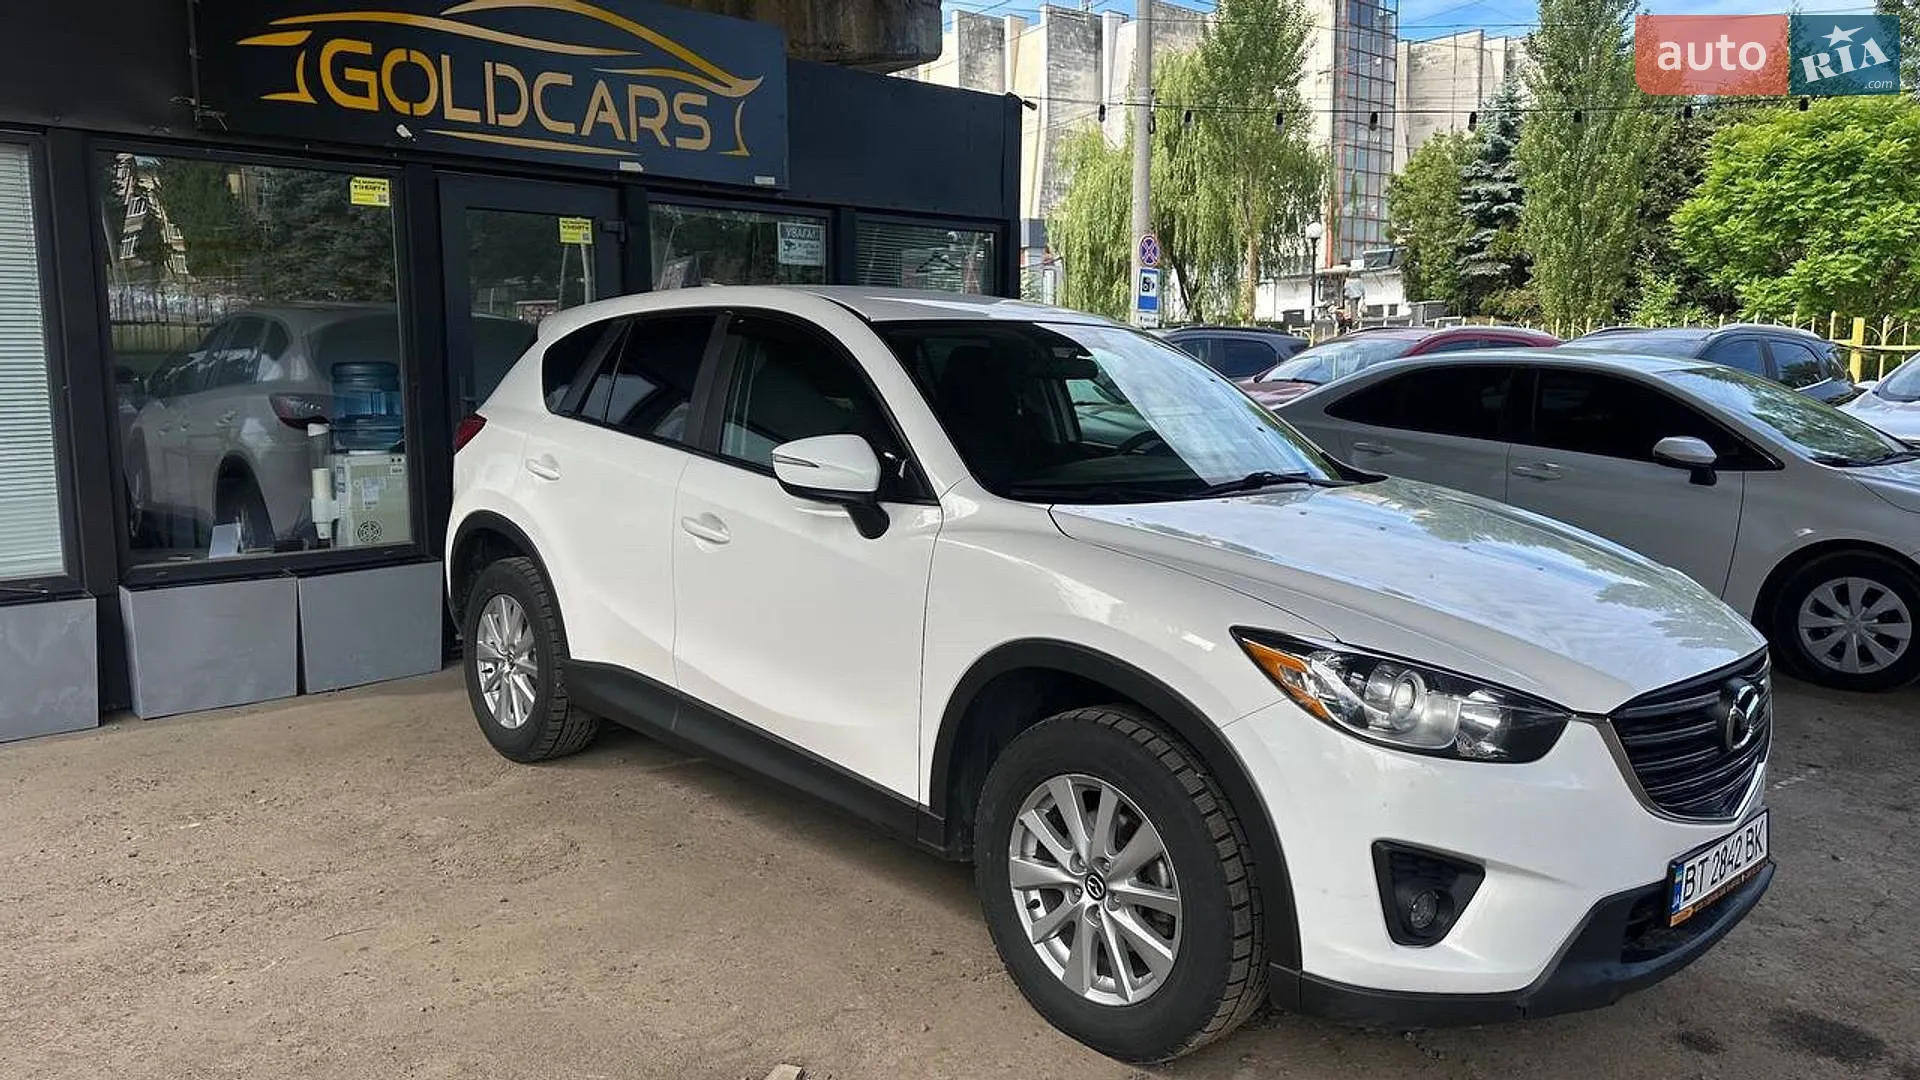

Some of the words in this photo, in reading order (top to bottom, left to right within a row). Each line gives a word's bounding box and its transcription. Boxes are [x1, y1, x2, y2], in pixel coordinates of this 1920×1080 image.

[319, 38, 711, 151] GOLDCARS
[1683, 856, 1709, 901] BT
[1710, 834, 1743, 886] 2842
[1745, 819, 1764, 862] BK
